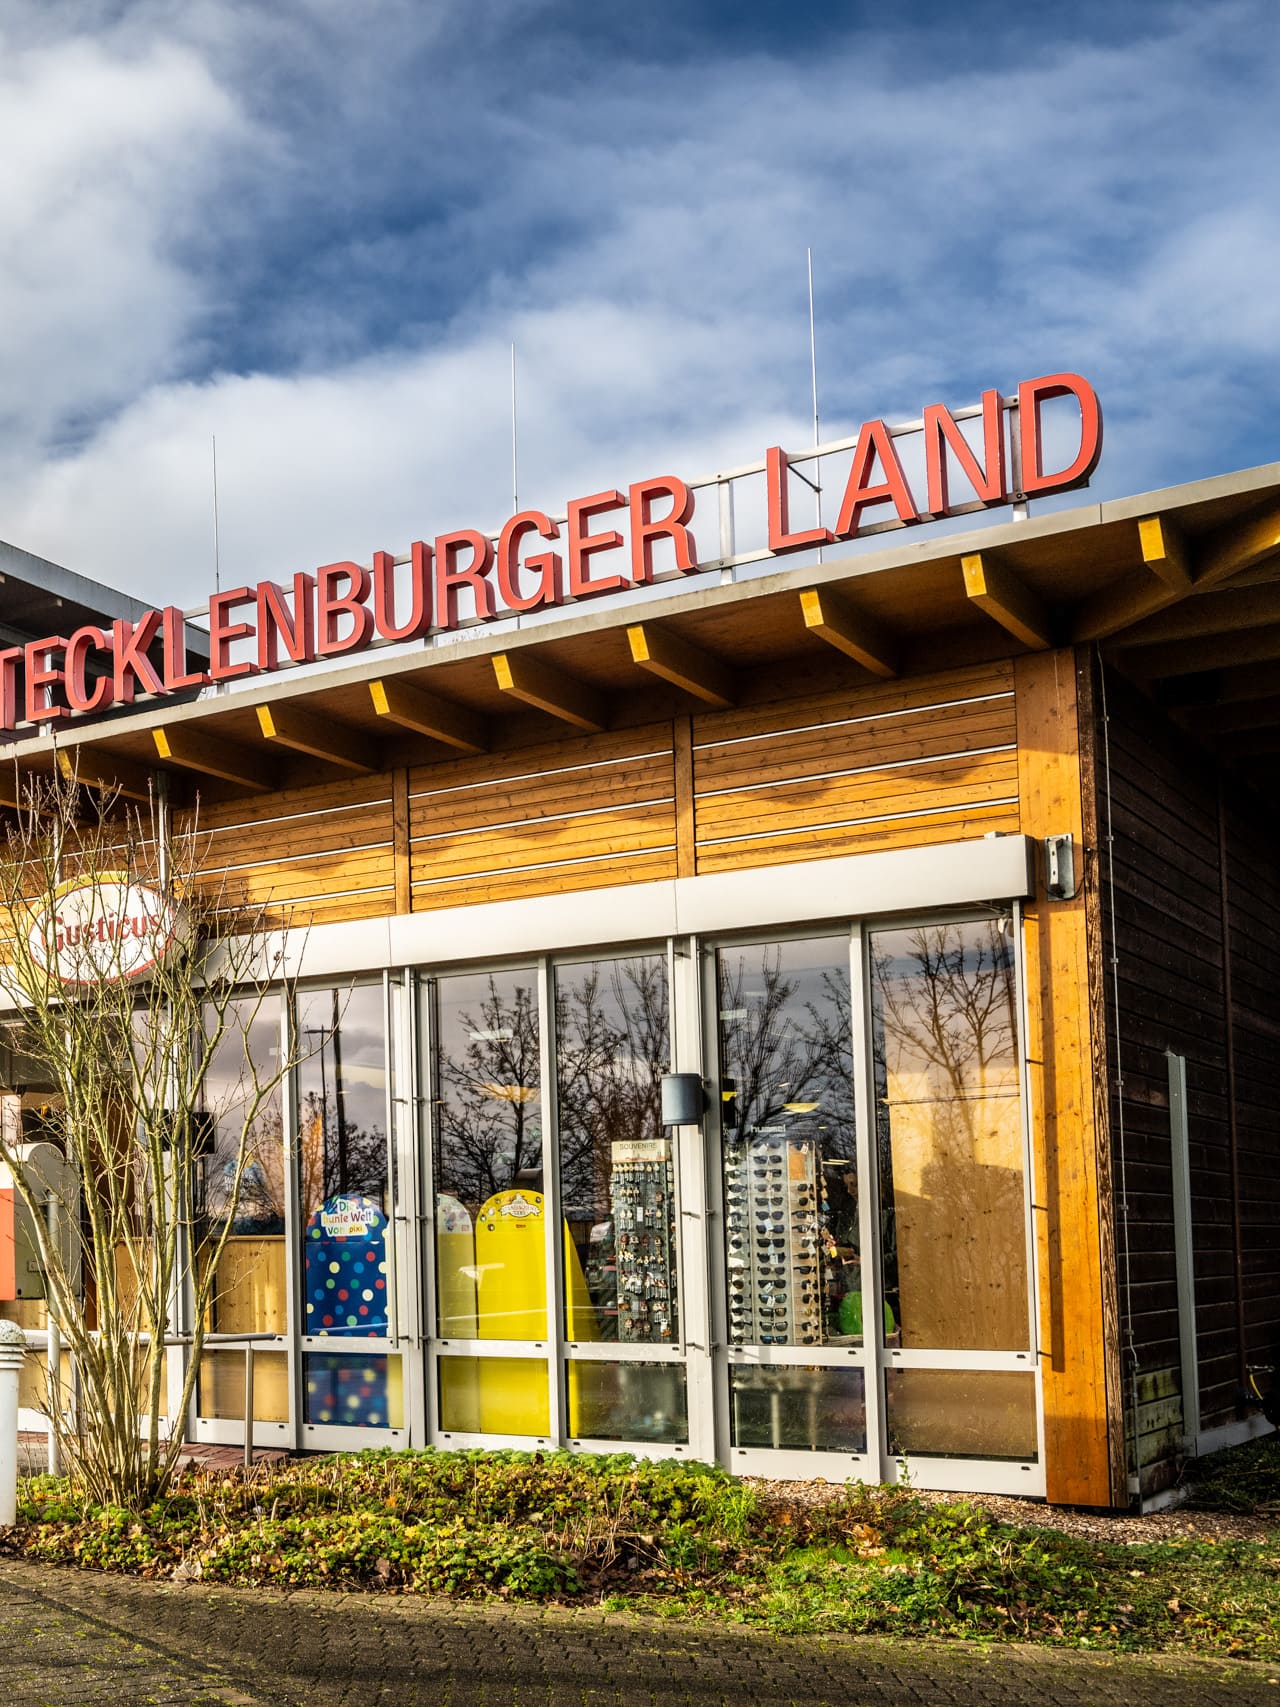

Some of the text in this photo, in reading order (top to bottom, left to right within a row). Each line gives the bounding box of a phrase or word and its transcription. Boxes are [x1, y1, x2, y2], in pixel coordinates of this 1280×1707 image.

[766, 373, 1103, 557] LAND
[40, 912, 162, 952] Gusticus
[750, 1124, 786, 1133] hummel
[619, 1142, 657, 1150] SOUVENIRS
[322, 1210, 372, 1225] bunte Welt
[327, 1225, 363, 1235] von pixi
